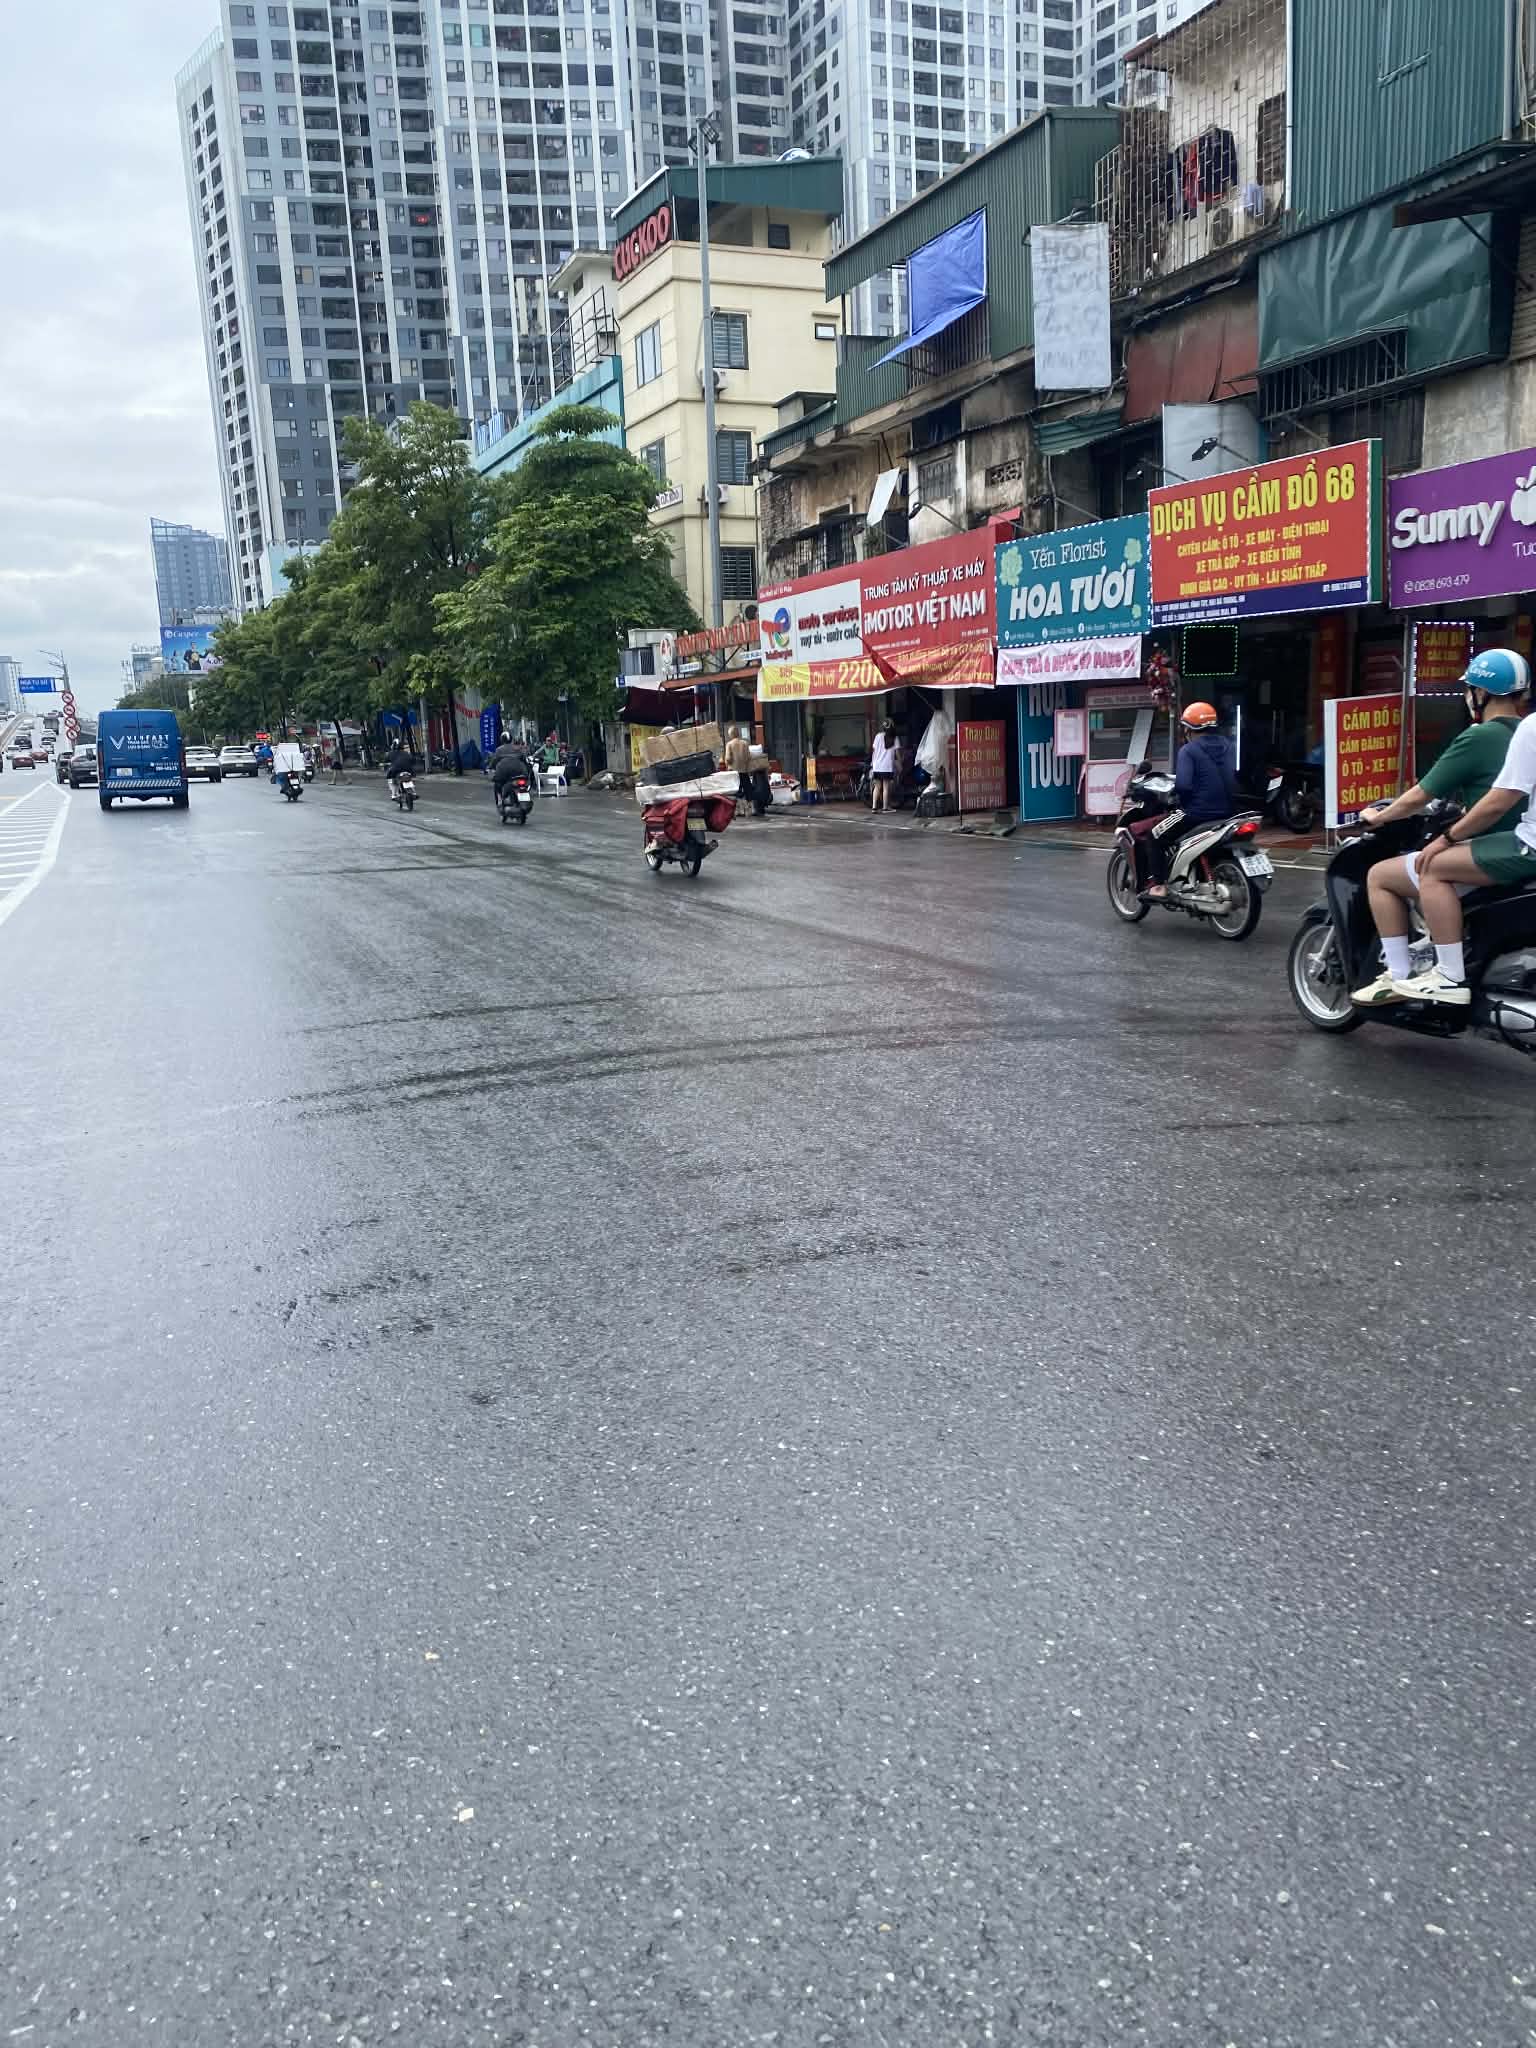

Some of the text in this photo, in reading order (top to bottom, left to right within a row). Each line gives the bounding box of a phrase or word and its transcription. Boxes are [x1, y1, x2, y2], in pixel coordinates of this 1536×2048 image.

[613, 206, 670, 281] CUCKOO
[1153, 458, 1356, 541] DỊCH VỤ CẦM ĐỒ 68
[1392, 500, 1505, 549] Sunny
[1030, 537, 1106, 570] Yến Florist
[864, 583, 890, 600] TRUNG
[922, 565, 950, 588] THUẬT
[952, 566, 964, 581] XE
[965, 556, 985, 577] MÁY
[1010, 562, 1136, 621] HOA TƯƠI
[916, 590, 950, 629] VIỆT
[950, 588, 987, 619] NAM
[1373, 758, 1385, 773] XE
